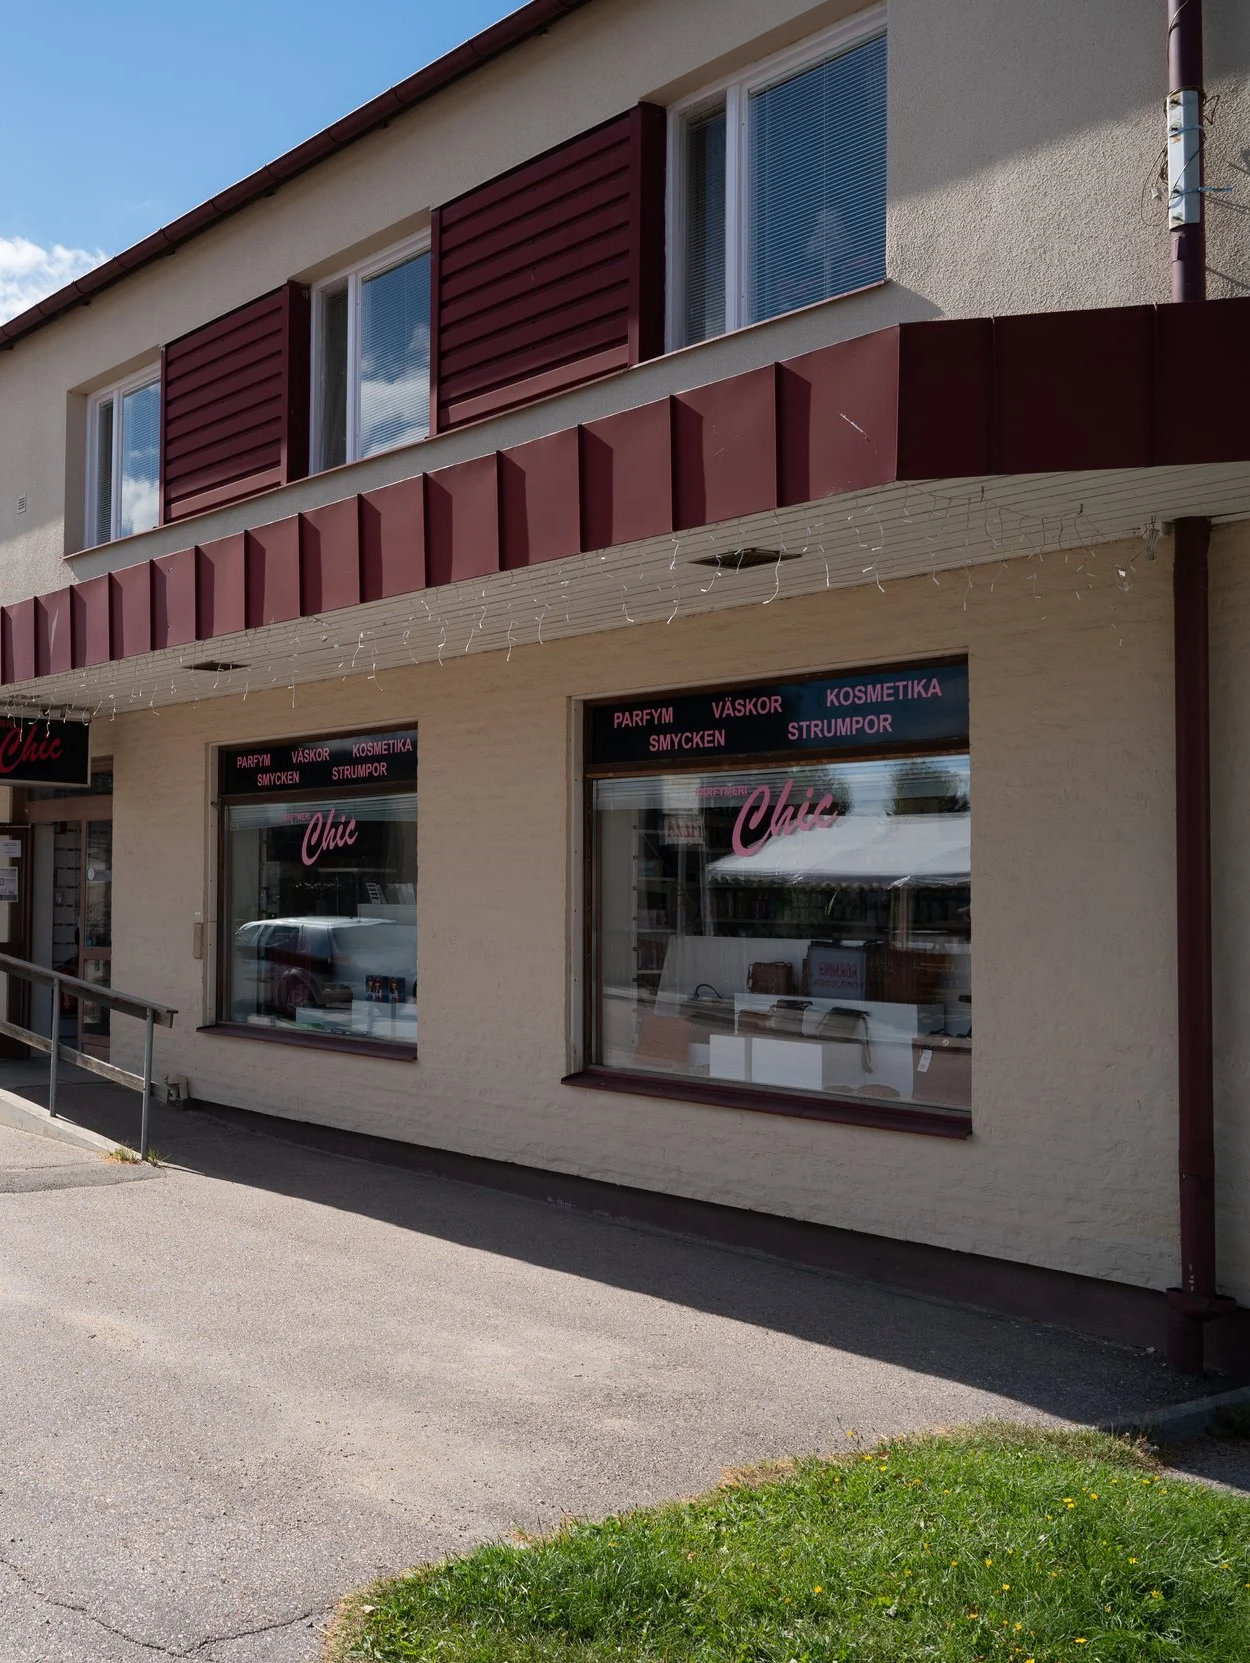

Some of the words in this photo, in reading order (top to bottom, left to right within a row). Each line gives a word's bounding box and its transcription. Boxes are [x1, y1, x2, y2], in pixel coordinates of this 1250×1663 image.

[613, 706, 674, 729] PARFYM
[711, 695, 783, 720] VÄSKOR
[826, 677, 943, 708] KOSMETIKA
[236, 753, 271, 769] PARFYM
[291, 747, 330, 764] VÄSKOR
[352, 737, 412, 758] KOSMETIKA
[648, 729, 726, 752] SMYCKEN
[787, 713, 893, 741] STRUMPOR
[256, 770, 300, 787] SMYCKEN
[332, 761, 388, 781] STRUMPOR
[301, 808, 359, 866] Chic
[731, 778, 838, 857] Chic
